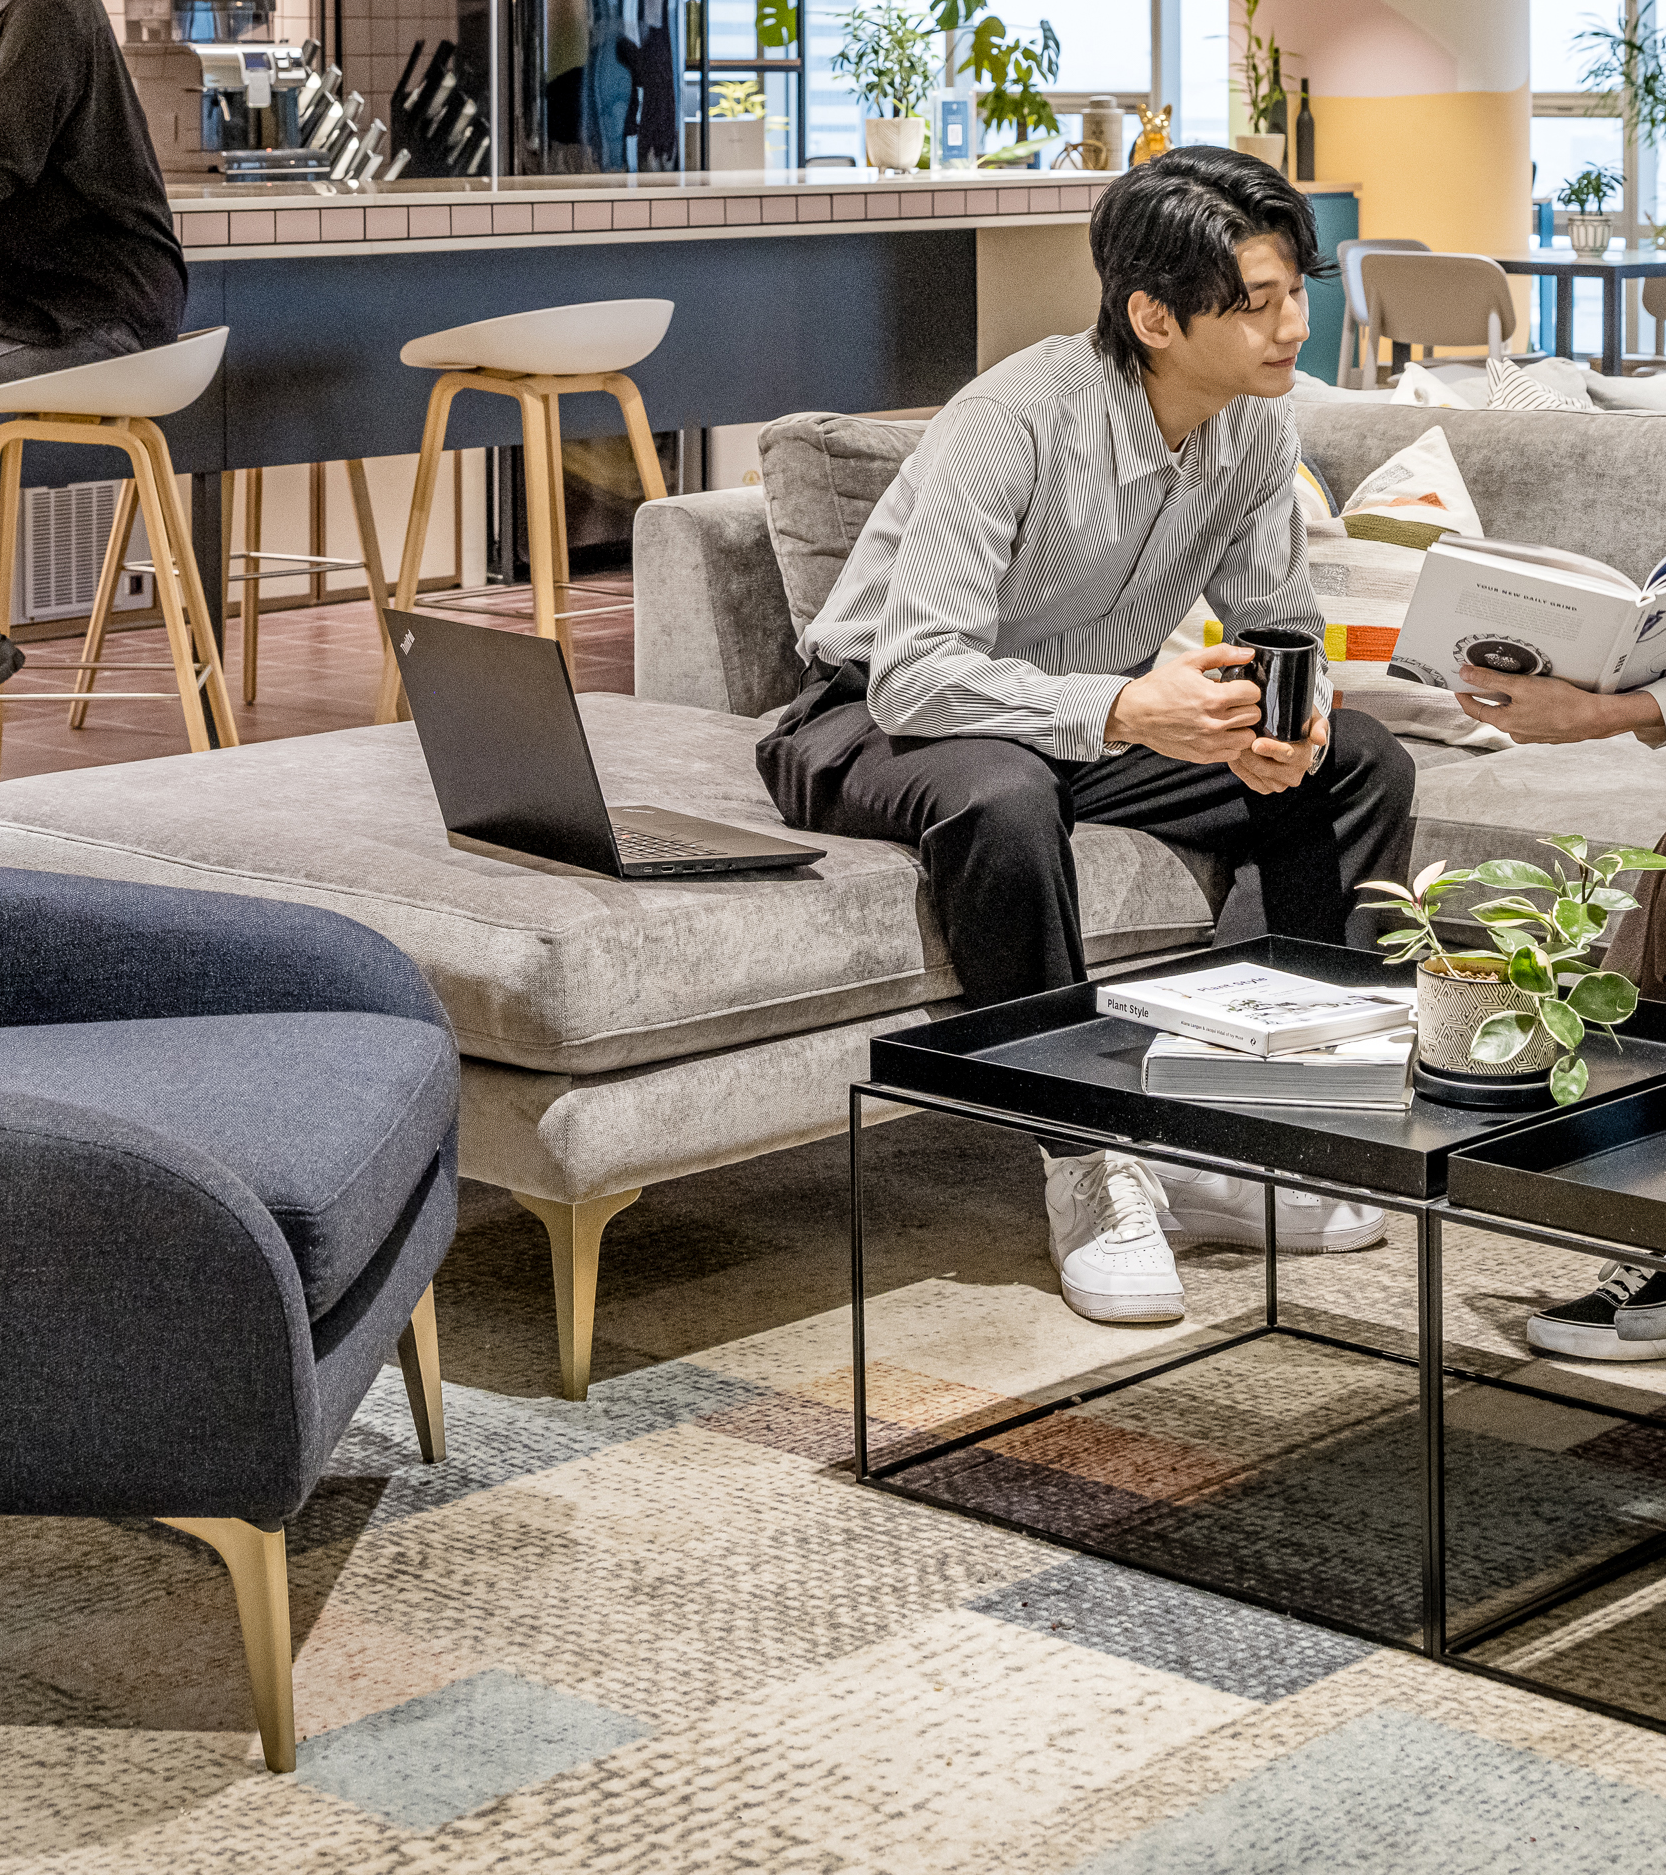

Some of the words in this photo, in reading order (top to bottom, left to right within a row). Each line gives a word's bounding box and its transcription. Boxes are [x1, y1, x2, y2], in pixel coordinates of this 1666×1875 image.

[1476, 583, 1499, 593] YOUR
[1501, 589, 1521, 598] NEW
[1523, 594, 1547, 605] DAILY
[1549, 601, 1578, 612] GRIND
[1613, 654, 1628, 674] BREW
[1107, 998, 1128, 1013] Plant
[1129, 1004, 1149, 1019] Style
